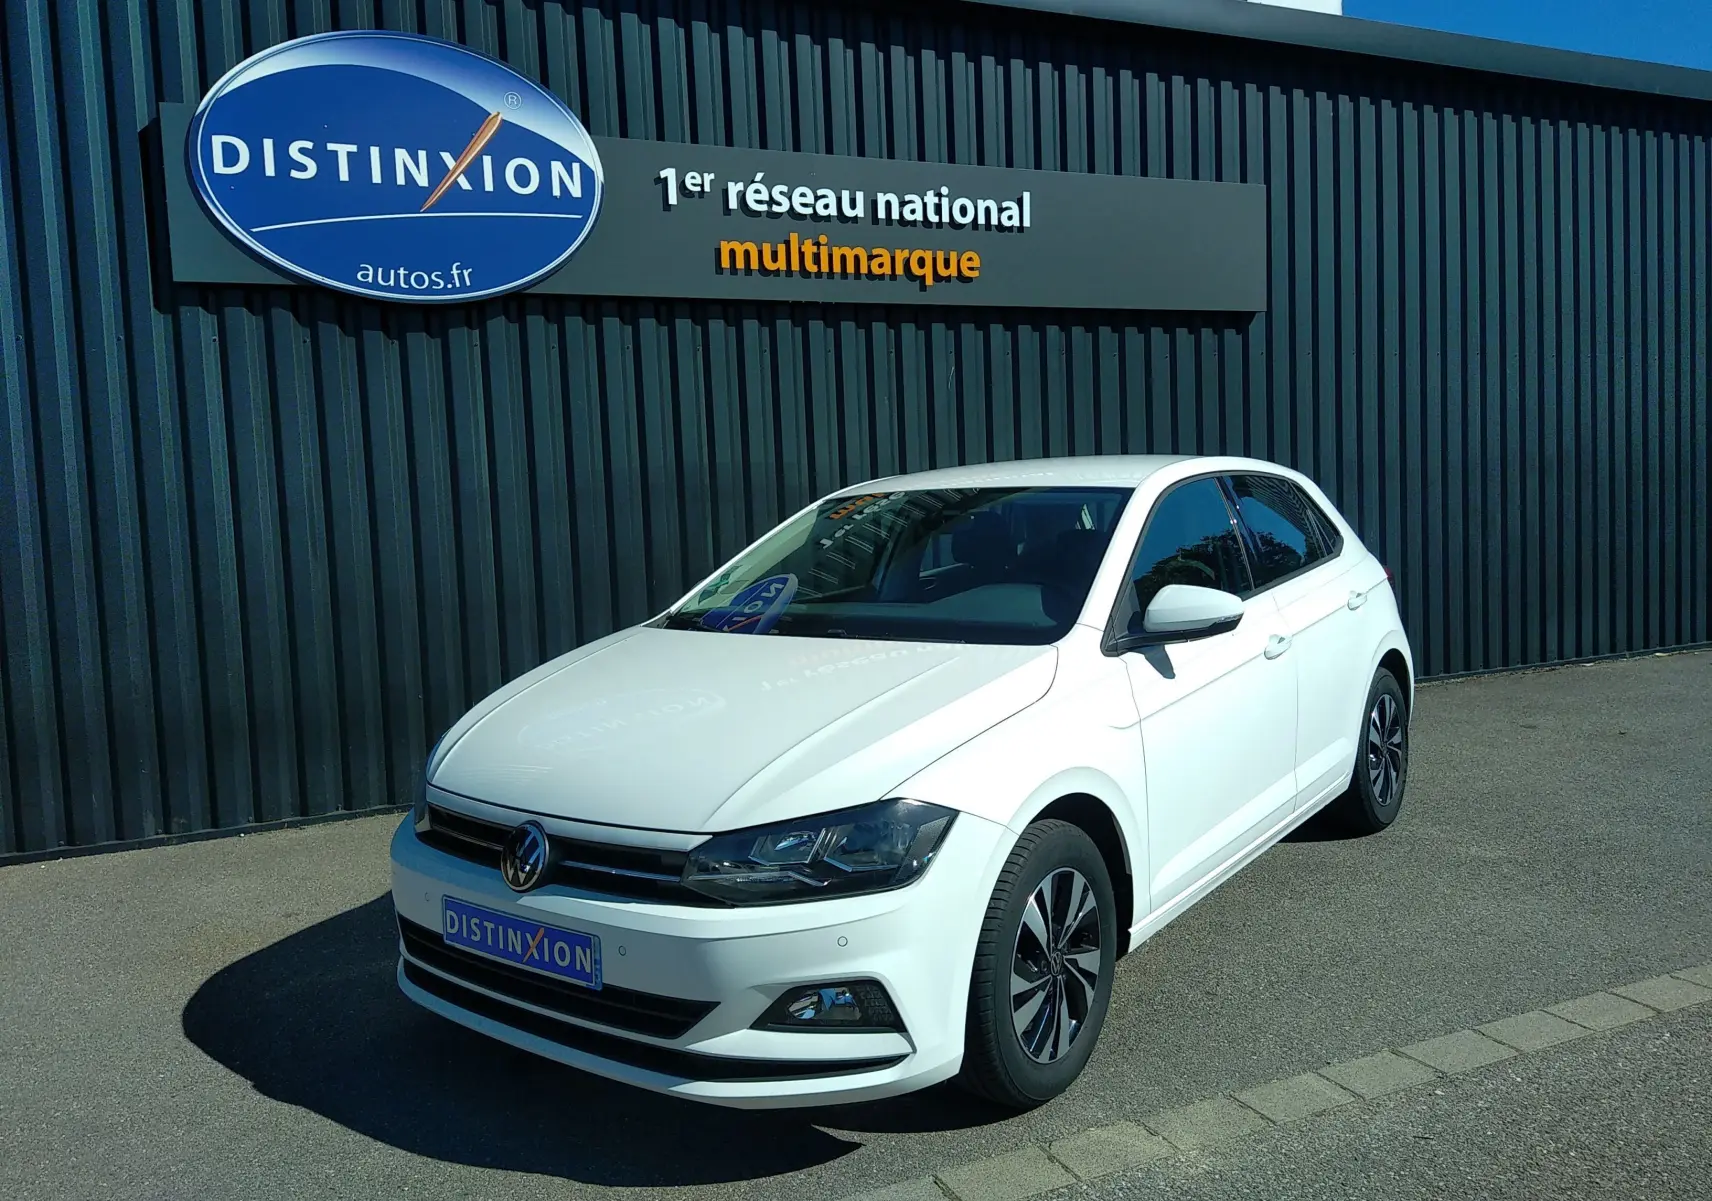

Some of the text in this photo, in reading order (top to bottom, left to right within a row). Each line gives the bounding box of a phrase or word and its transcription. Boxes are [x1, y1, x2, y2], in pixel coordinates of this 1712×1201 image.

[211, 111, 583, 212] DISTINXION
[659, 167, 1031, 228] 1er réseau national
[356, 262, 474, 290] autos.fr
[720, 233, 981, 286] multimarque
[446, 909, 592, 974] DISTINXION
